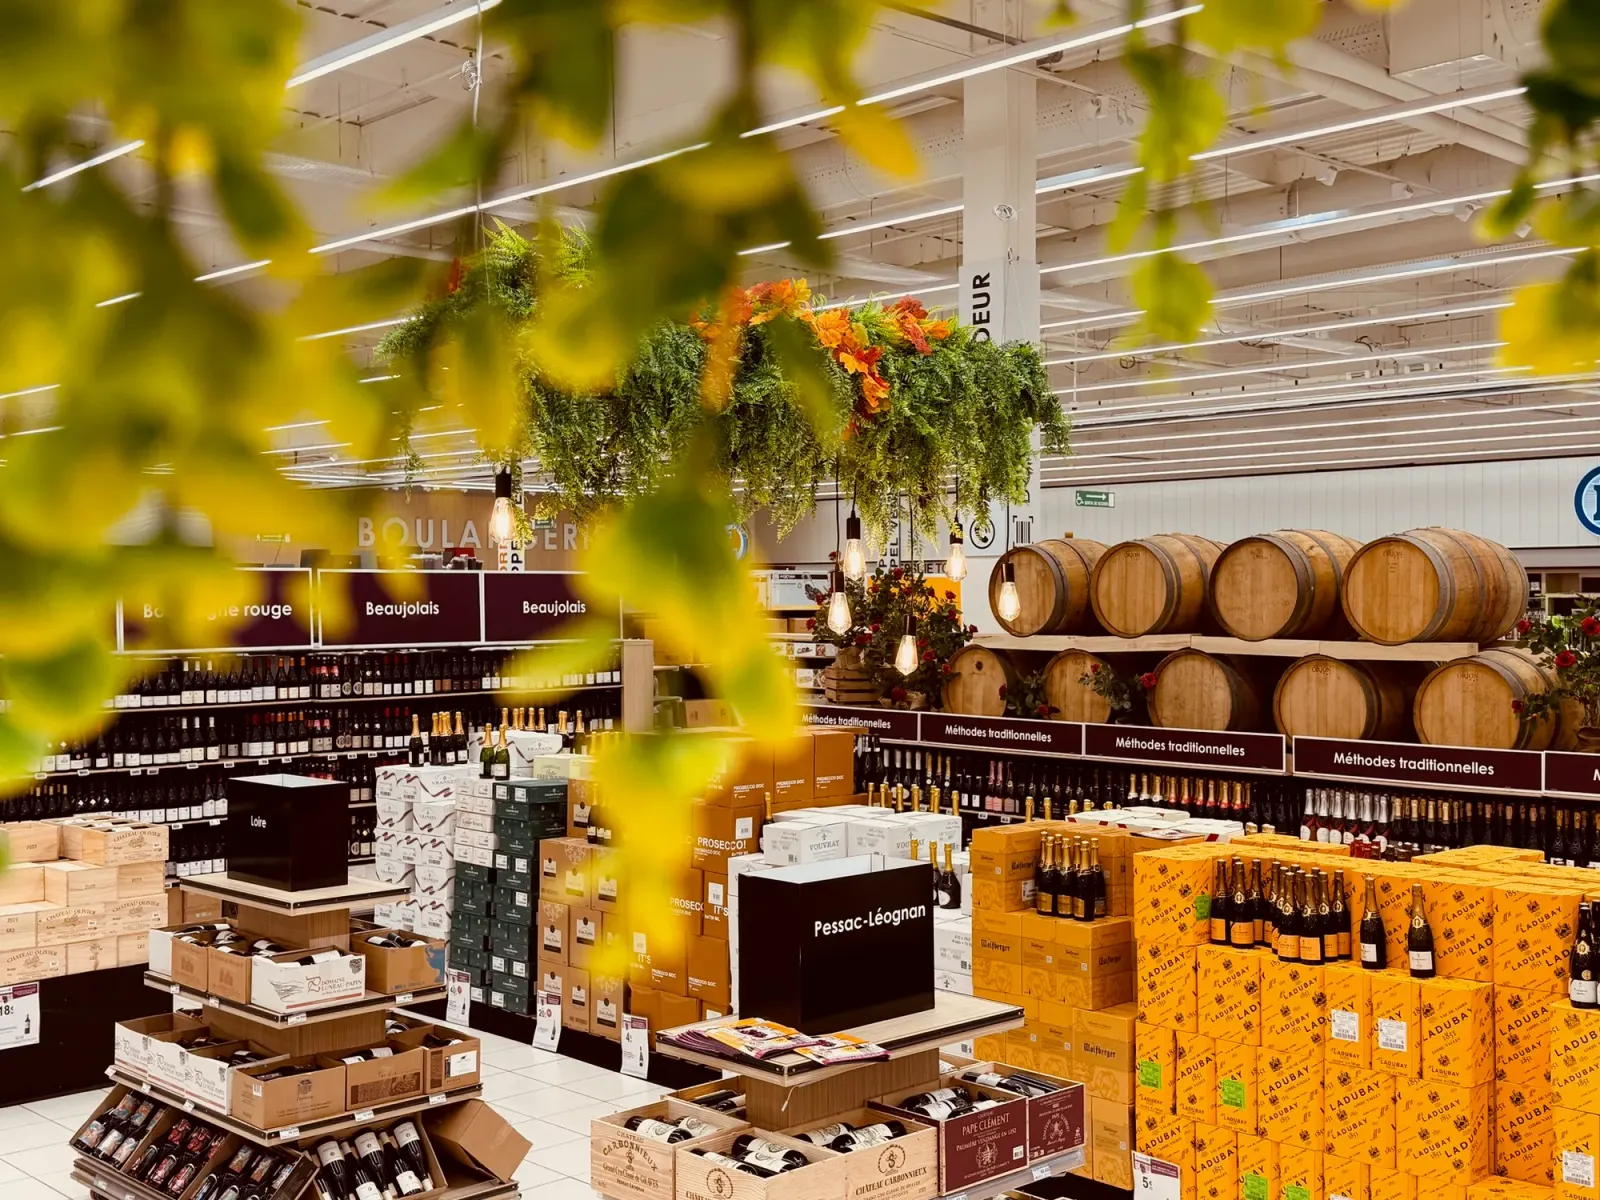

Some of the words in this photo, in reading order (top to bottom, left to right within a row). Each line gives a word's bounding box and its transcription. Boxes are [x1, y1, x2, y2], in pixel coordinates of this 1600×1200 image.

[243, 602, 293, 620] rouge
[366, 600, 440, 618] Beaujolais
[522, 600, 586, 617] Beaujolais
[802, 713, 837, 726] Méthodes
[838, 716, 892, 729] traditionnelles
[945, 724, 986, 738] Méthodes
[988, 730, 1052, 742] traditionnelles
[1115, 737, 1166, 751] Méthodes
[1168, 740, 1246, 756] traditionnelles
[1334, 752, 1396, 768] Méthodes
[1399, 757, 1494, 776] traditionnelles
[250, 815, 267, 828] Loire
[697, 836, 746, 850] PROSECCO!
[810, 840, 840, 851] VOUVRAY
[1153, 870, 1185, 892] LADUBAY
[714, 904, 729, 916] IT'S
[1380, 888, 1412, 910] ADUBAY
[1446, 896, 1486, 922] LADUBAY
[814, 904, 926, 937] Pessac-Léognan
[1146, 904, 1177, 926] LADUBAY
[1520, 906, 1562, 933] LADUBAY
[980, 939, 1010, 952] Wolfberger
[1437, 934, 1476, 959] LADUBAY
[1141, 951, 1186, 982] LADUBAY
[1512, 945, 1552, 972] LADUBAY
[1218, 965, 1250, 988] LADUBAY
[1143, 986, 1175, 1008] LADUBAY
[1282, 976, 1318, 1000] LADUBAY
[1210, 1000, 1242, 1022] LADUBAY
[1275, 1012, 1310, 1035] LADUBAY
[1084, 1042, 1116, 1058] Wolfberger
[1332, 1048, 1360, 1058] LADUBAY
[1502, 1041, 1542, 1065] LADUBAY
[1380, 1059, 1408, 1068] LADUBAY
[1431, 1066, 1460, 1077] LADUBAY
[1262, 1065, 1310, 1096] LADUBAY
[1557, 1062, 1600, 1088] LADUBAY
[1329, 1080, 1381, 1112] LADUBAY
[1264, 1102, 1299, 1124] LADUBAY
[1422, 1098, 1460, 1122] LADUBAY
[962, 1122, 978, 1136] PAPE
[979, 1112, 1010, 1130] CLÉMENT
[1331, 1118, 1368, 1140] LADUBAY
[1138, 1126, 1181, 1152] LADUBAY
[1412, 1136, 1452, 1160] LADUBAY
[1504, 1138, 1544, 1162] LADUBAY
[602, 1140, 658, 1172] CARBONNIEUX
[884, 1166, 927, 1186] CARBONNIEUX
